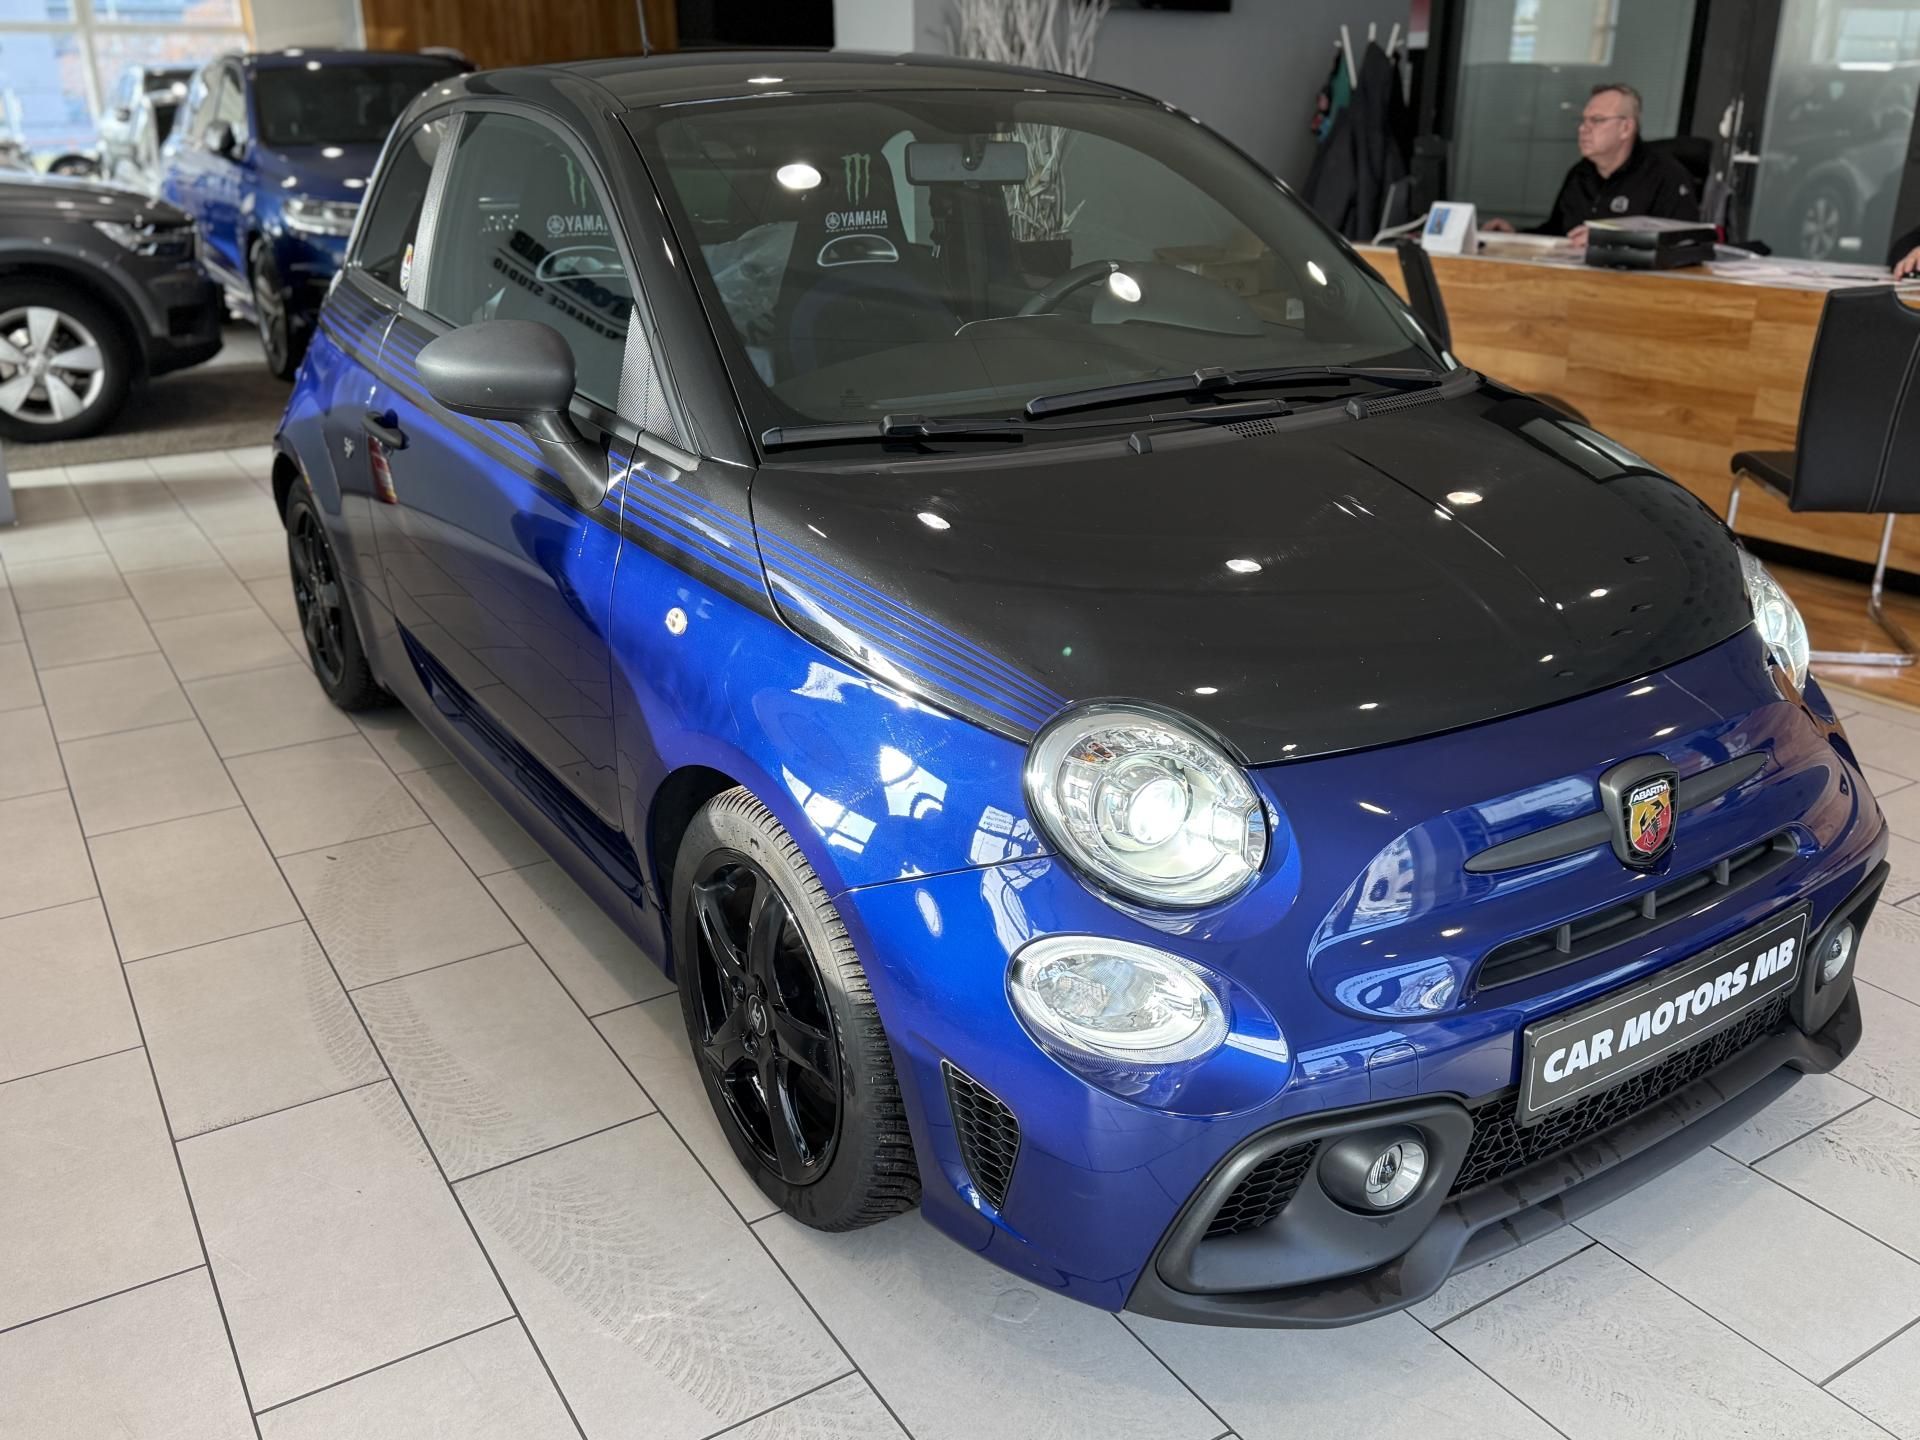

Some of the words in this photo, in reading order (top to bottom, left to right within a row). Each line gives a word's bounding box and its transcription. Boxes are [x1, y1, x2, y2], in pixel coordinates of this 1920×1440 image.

[564, 215, 609, 232] YAMA
[840, 209, 888, 227] YAMAHA
[1633, 783, 1668, 803] ABARTH
[1543, 1027, 1614, 1083] CAR
[1617, 961, 1750, 1053] MOTORS
[1750, 937, 1796, 987] MB
